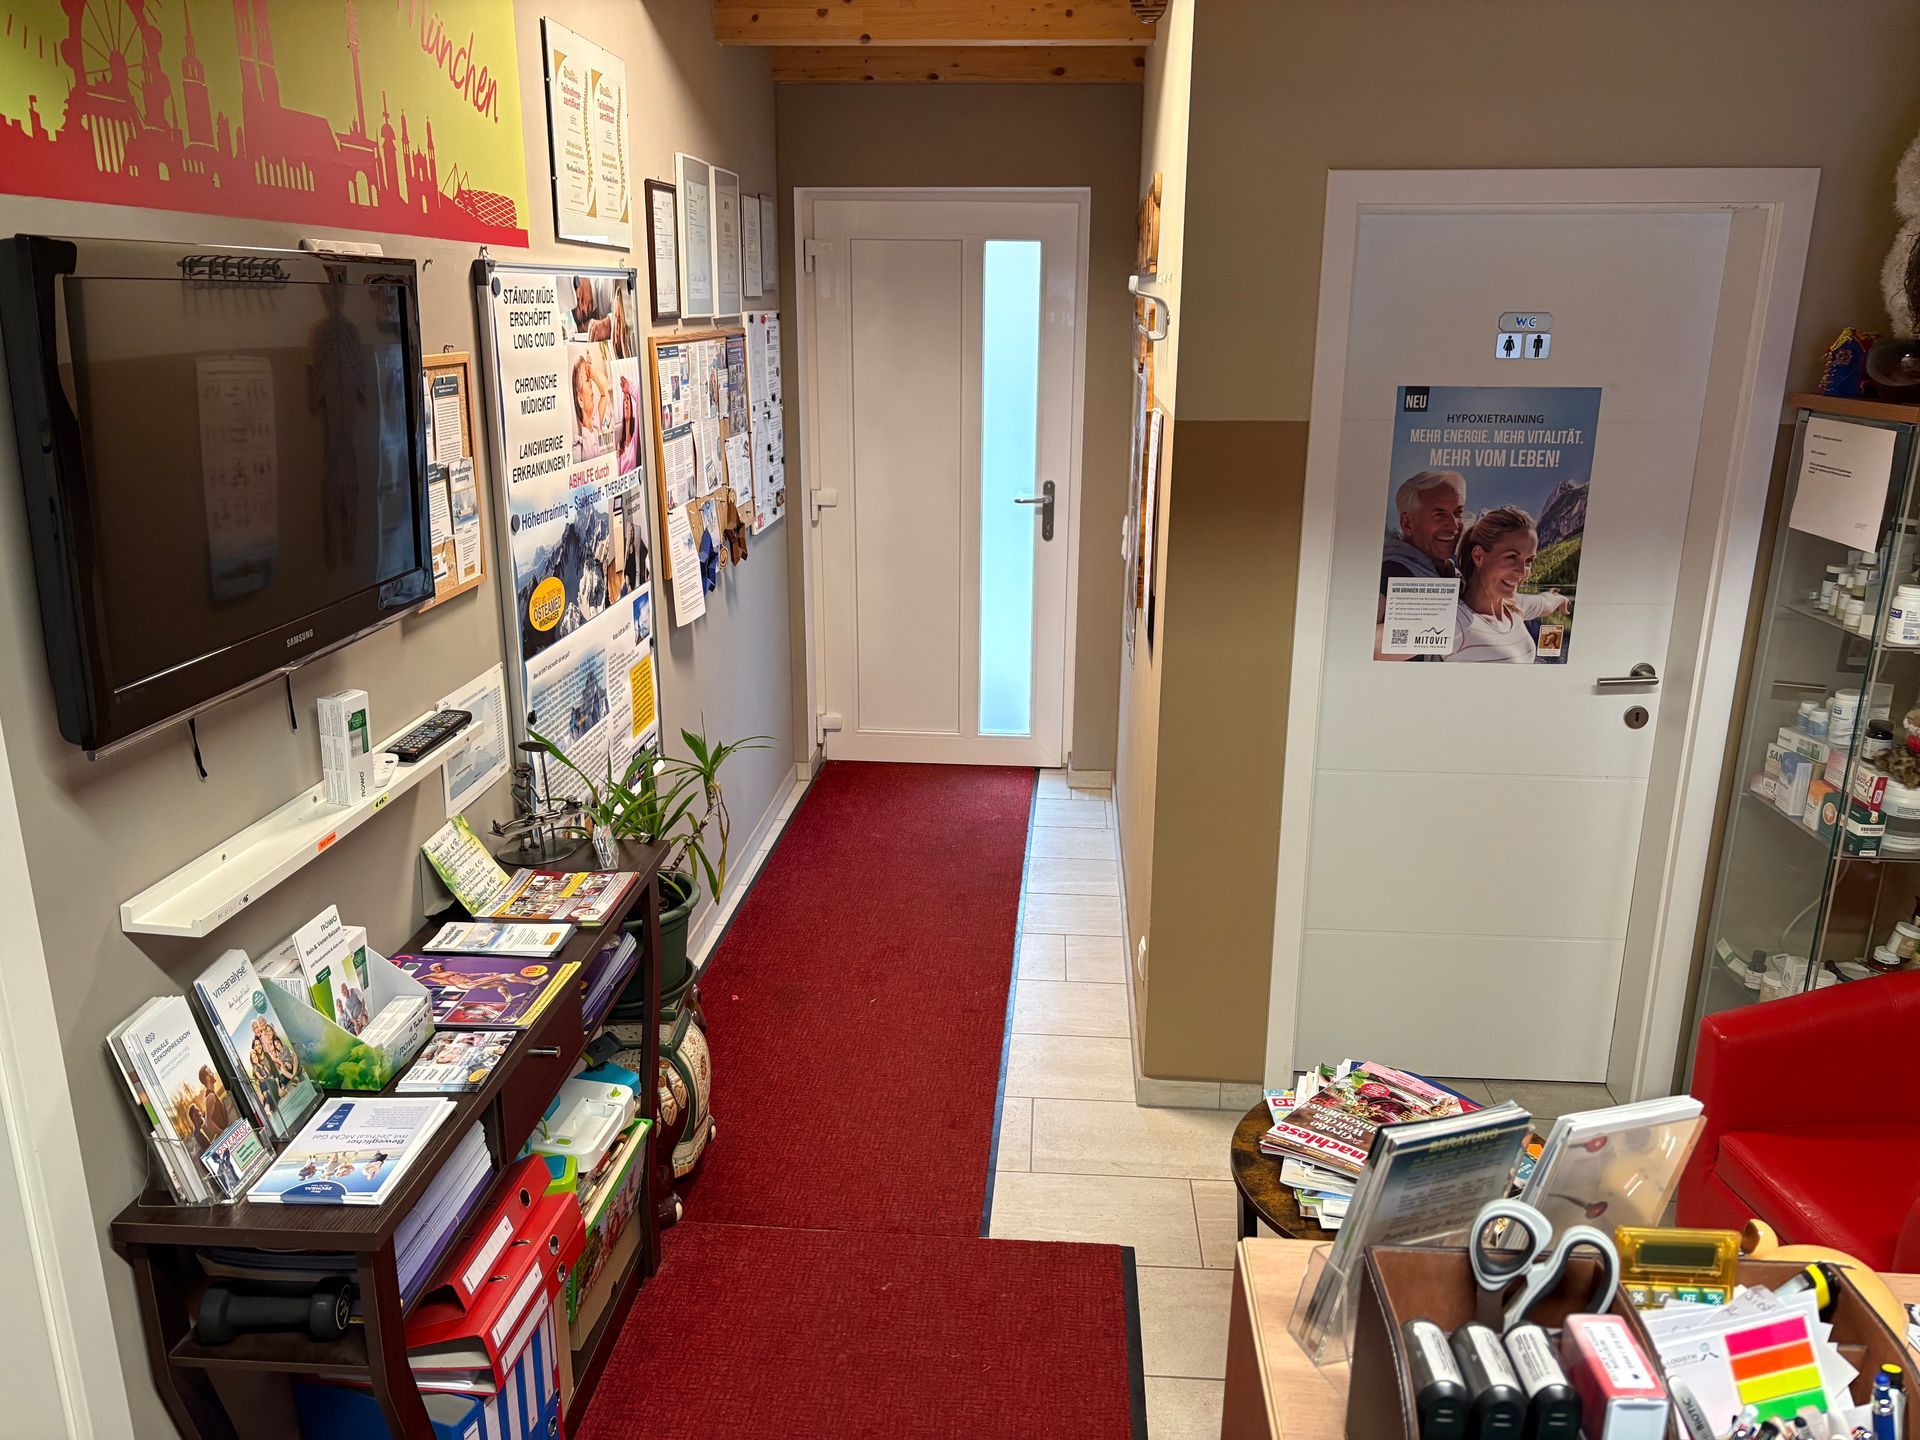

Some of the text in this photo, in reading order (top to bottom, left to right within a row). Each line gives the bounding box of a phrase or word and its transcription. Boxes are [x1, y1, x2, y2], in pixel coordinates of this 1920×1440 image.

[503, 286, 555, 305] STÄNDIG MÜDE
[509, 308, 552, 327] ERSCHÖPFT
[1515, 316, 1537, 329] WC
[513, 332, 556, 350] LONG COVID
[514, 373, 558, 395] CHRONISCHE
[520, 395, 556, 416] MÜDIGKEIT
[1405, 394, 1428, 409] NEU
[1446, 413, 1545, 424] HYPOXIETRAINING
[1409, 428, 1584, 445] MEHR ENERGIE. MEHR VITALITÄT.
[519, 435, 564, 460] LANGWIERIGE
[1429, 448, 1560, 468] MEHR VOM LEBEN!
[512, 453, 571, 484] ERKRANKUNGEN ?
[568, 464, 610, 490] ABHILFE durch
[521, 501, 569, 531] Höhentraining
[574, 486, 602, 511] Sauerstoff
[605, 475, 628, 499] THERAPIE
[286, 628, 314, 648] SAMSUNG
[1414, 636, 1448, 645] MITOVIT
[151, 1038, 170, 1058] SPINALE
[153, 1029, 191, 1065] DEKOMPRESSION
[1311, 1103, 1377, 1135] inkochens
[1313, 1112, 1365, 1137] Welt des
